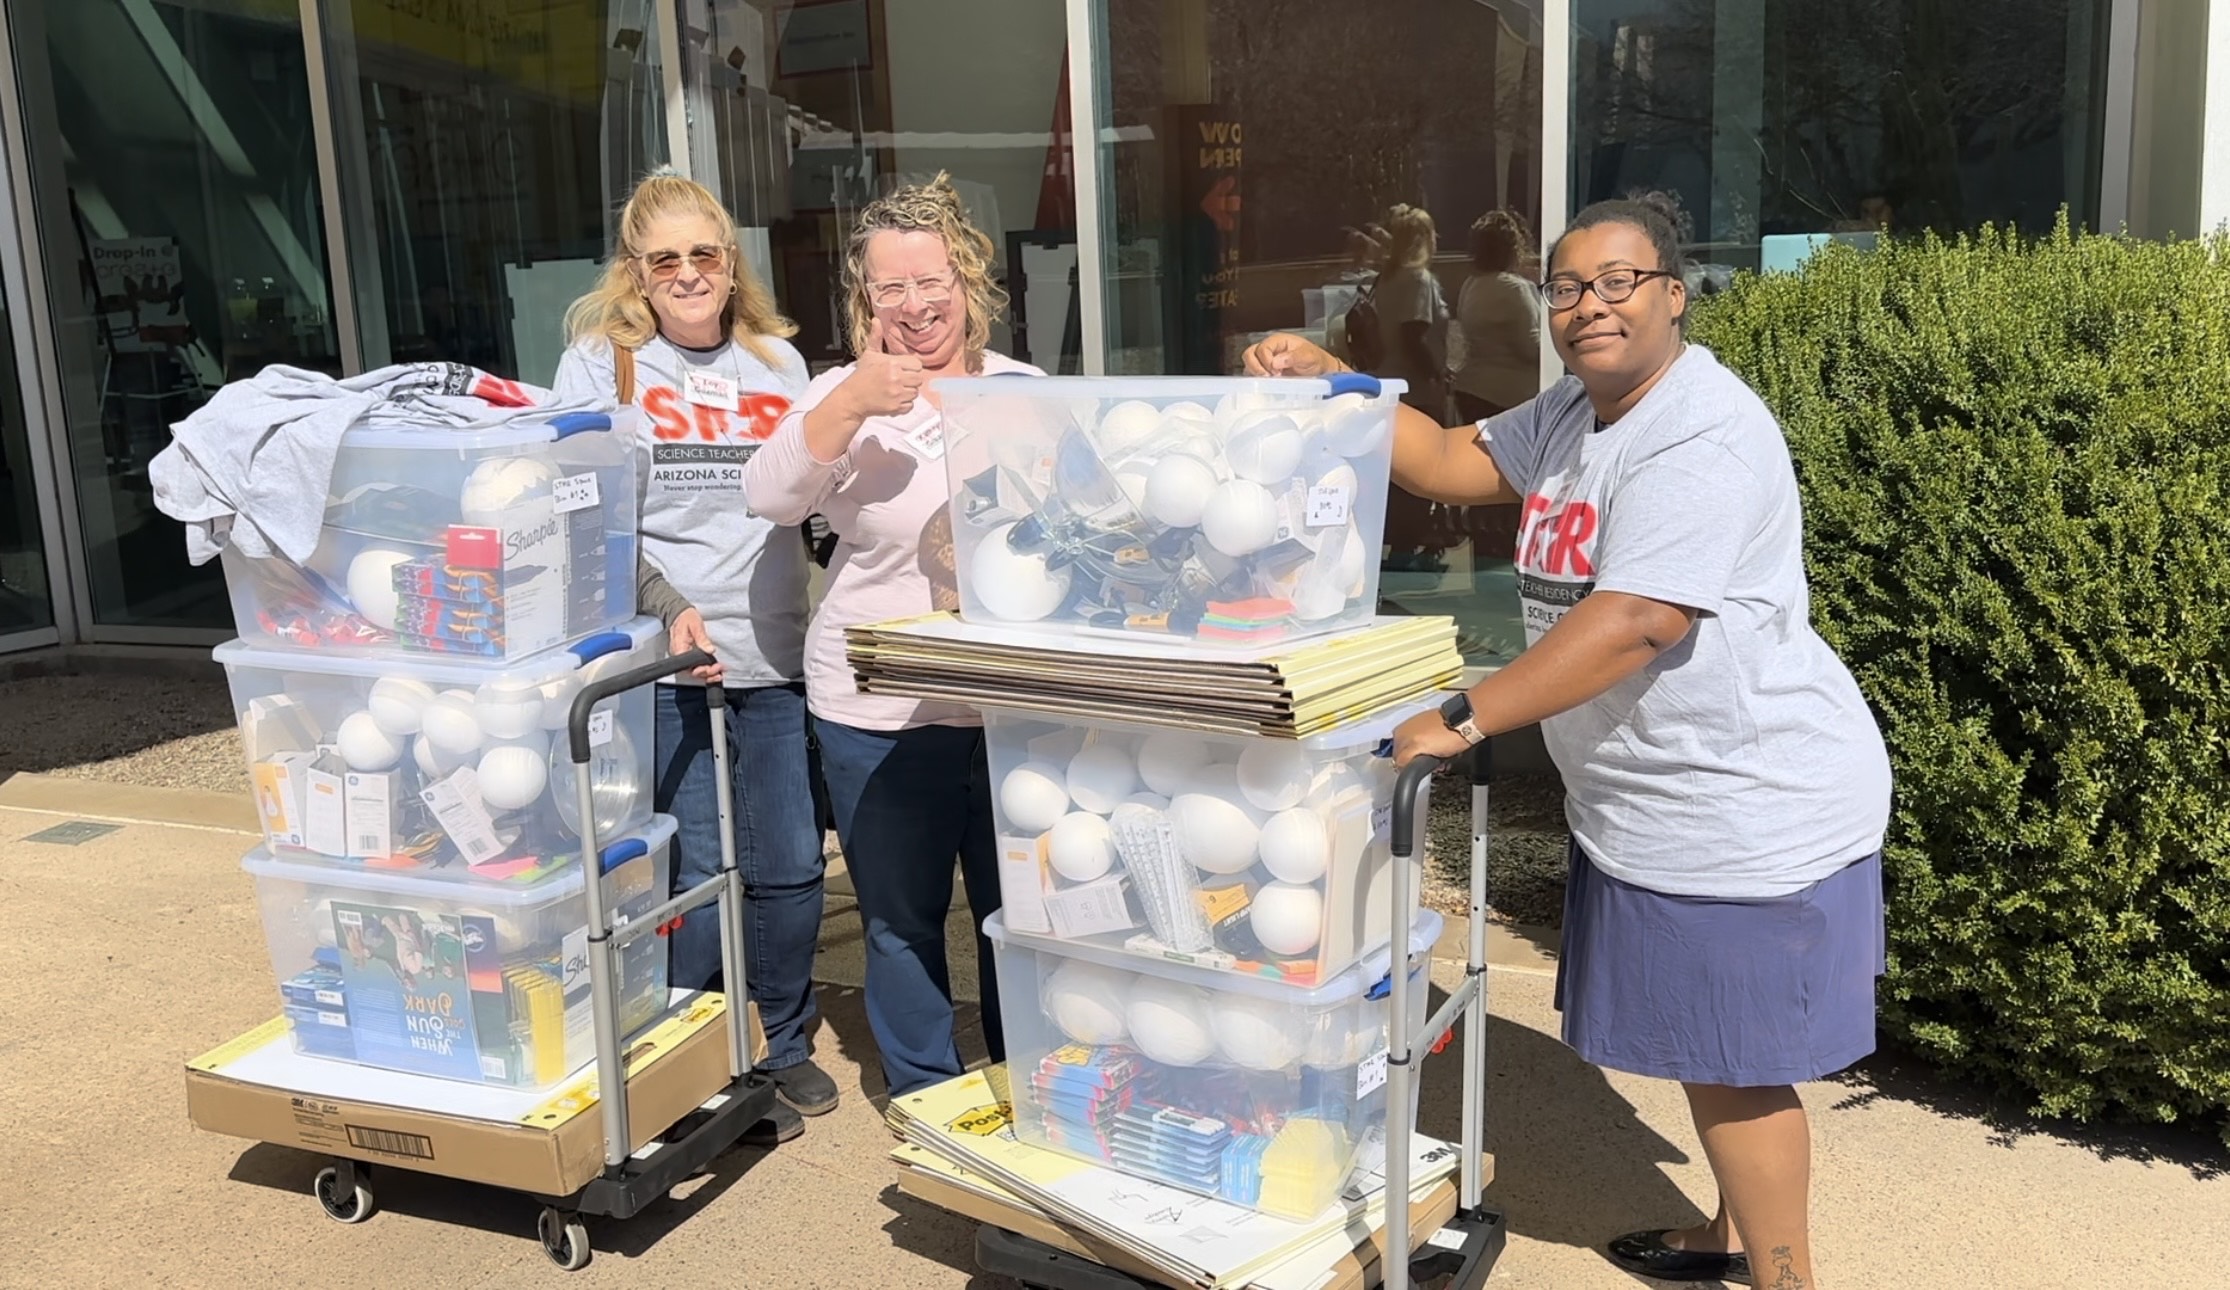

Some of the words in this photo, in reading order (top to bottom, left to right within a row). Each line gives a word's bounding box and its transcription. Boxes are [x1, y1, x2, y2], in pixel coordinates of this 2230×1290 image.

[657, 449, 705, 459] SCIENCE
[654, 469, 717, 481] ARIZONA
[504, 518, 559, 561] Sharpie
[402, 992, 453, 1017] DARK
[405, 1014, 445, 1040] SUN
[410, 1035, 454, 1057] WHEN
